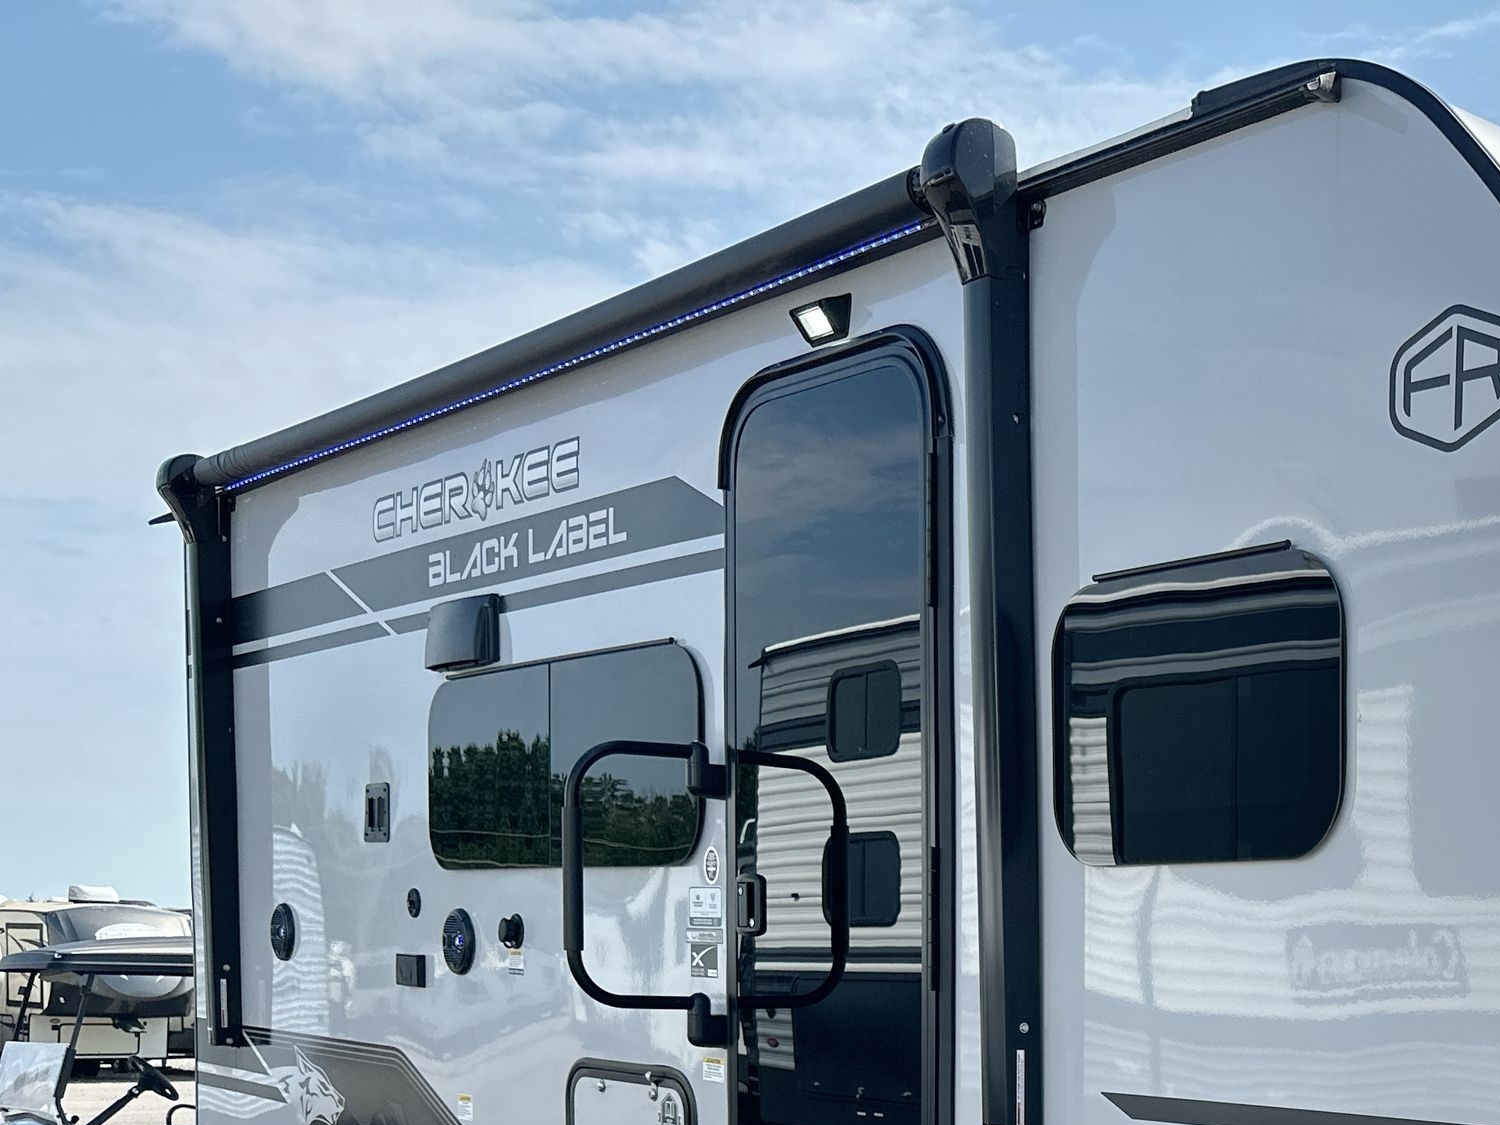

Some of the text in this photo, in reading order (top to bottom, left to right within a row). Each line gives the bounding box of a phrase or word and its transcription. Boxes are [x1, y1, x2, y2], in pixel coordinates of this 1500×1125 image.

[373, 436, 580, 543] CHEROKEE
[428, 507, 628, 588] BLACK LABEL
